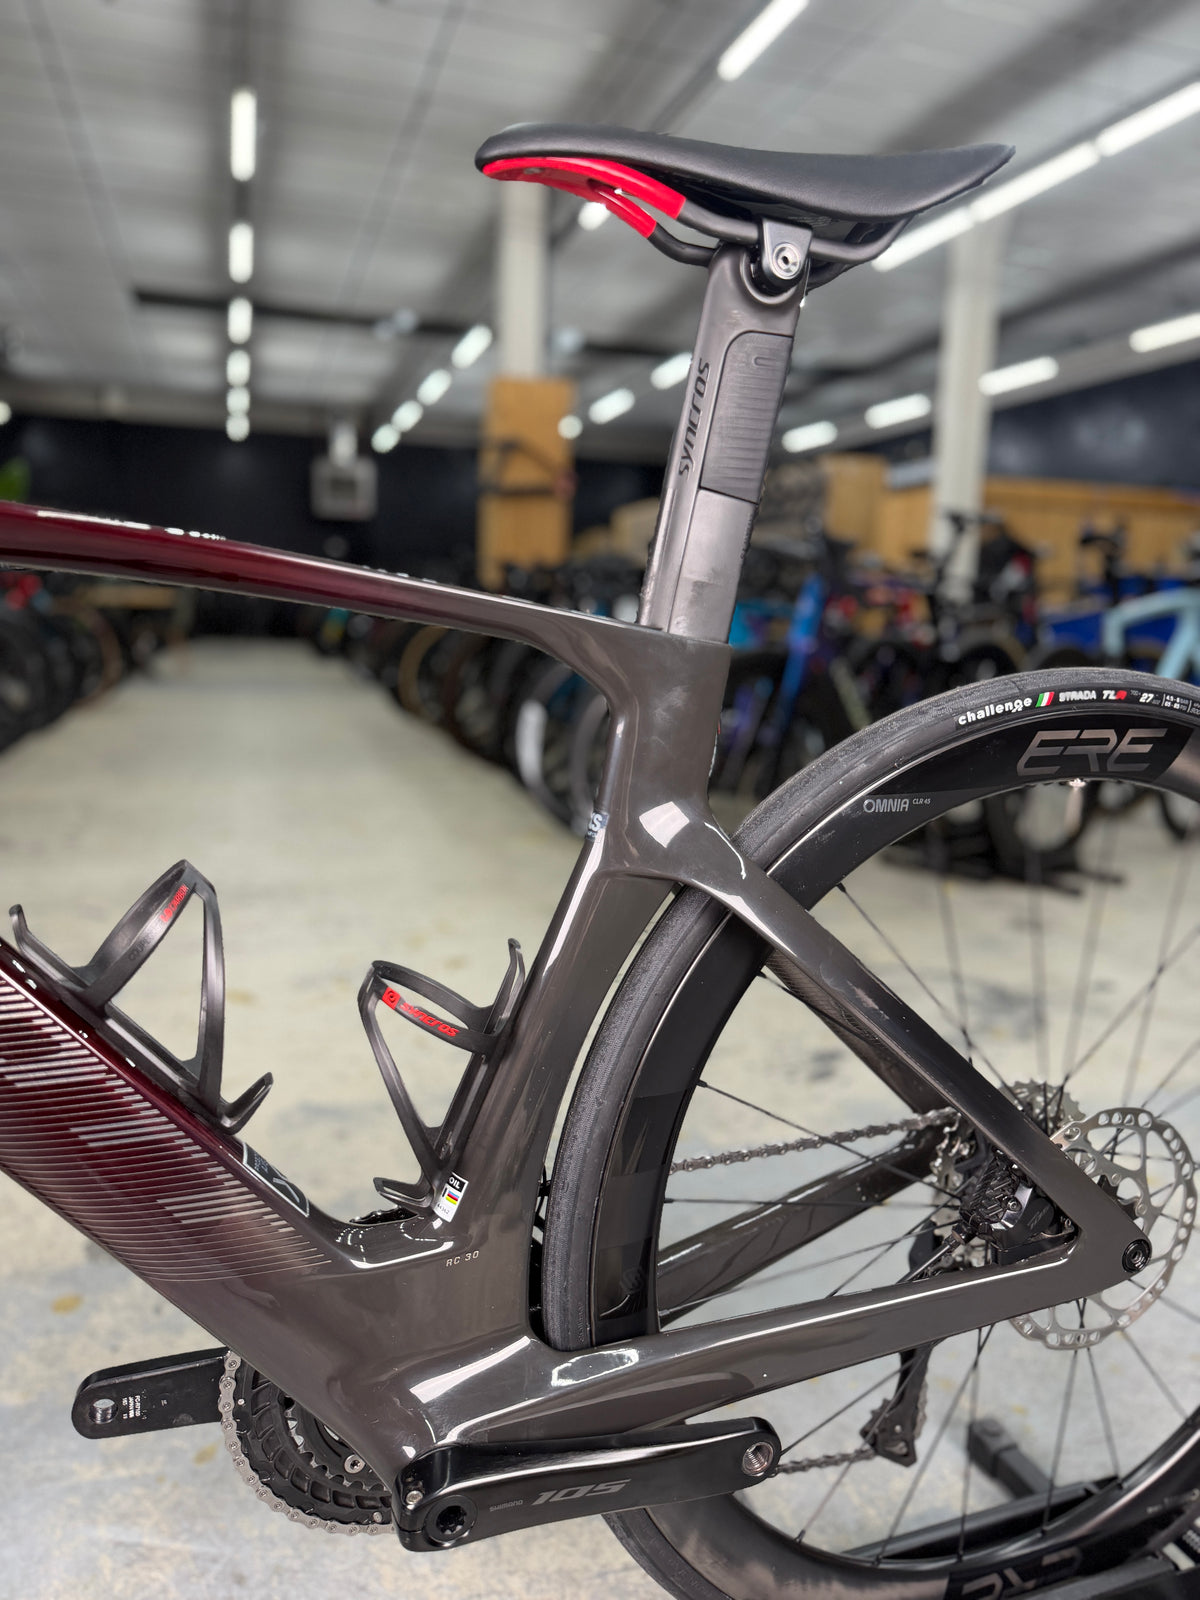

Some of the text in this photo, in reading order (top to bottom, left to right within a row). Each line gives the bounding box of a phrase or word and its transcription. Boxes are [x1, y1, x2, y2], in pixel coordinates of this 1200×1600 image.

[678, 357, 709, 476] syncros
[958, 697, 1032, 725] challenge
[1058, 690, 1097, 702] STRADA
[1102, 690, 1127, 700] TLR
[1139, 692, 1154, 703] 27
[1016, 728, 1167, 777] ERE
[863, 798, 909, 813] OMNIA
[448, 1176, 461, 1189] OIL
[446, 1250, 479, 1267] RC 30
[532, 1478, 631, 1506] 105
